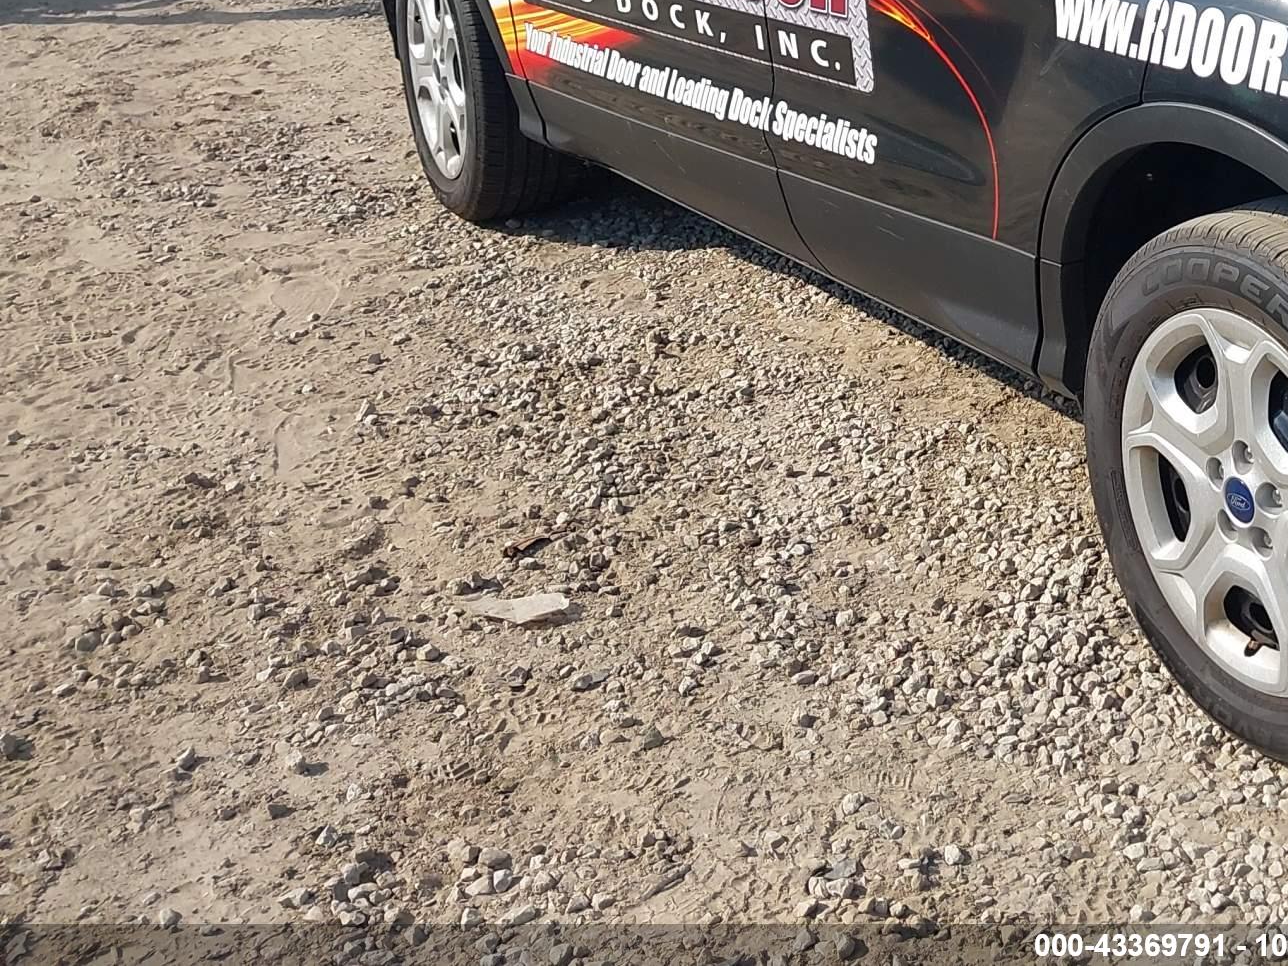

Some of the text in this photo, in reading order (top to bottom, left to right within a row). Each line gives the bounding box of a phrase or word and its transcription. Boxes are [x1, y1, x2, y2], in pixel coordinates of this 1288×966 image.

[524, 21, 878, 165] Your Industrial Door and Loading Dock Specialists
[754, 24, 842, 71] INC.
